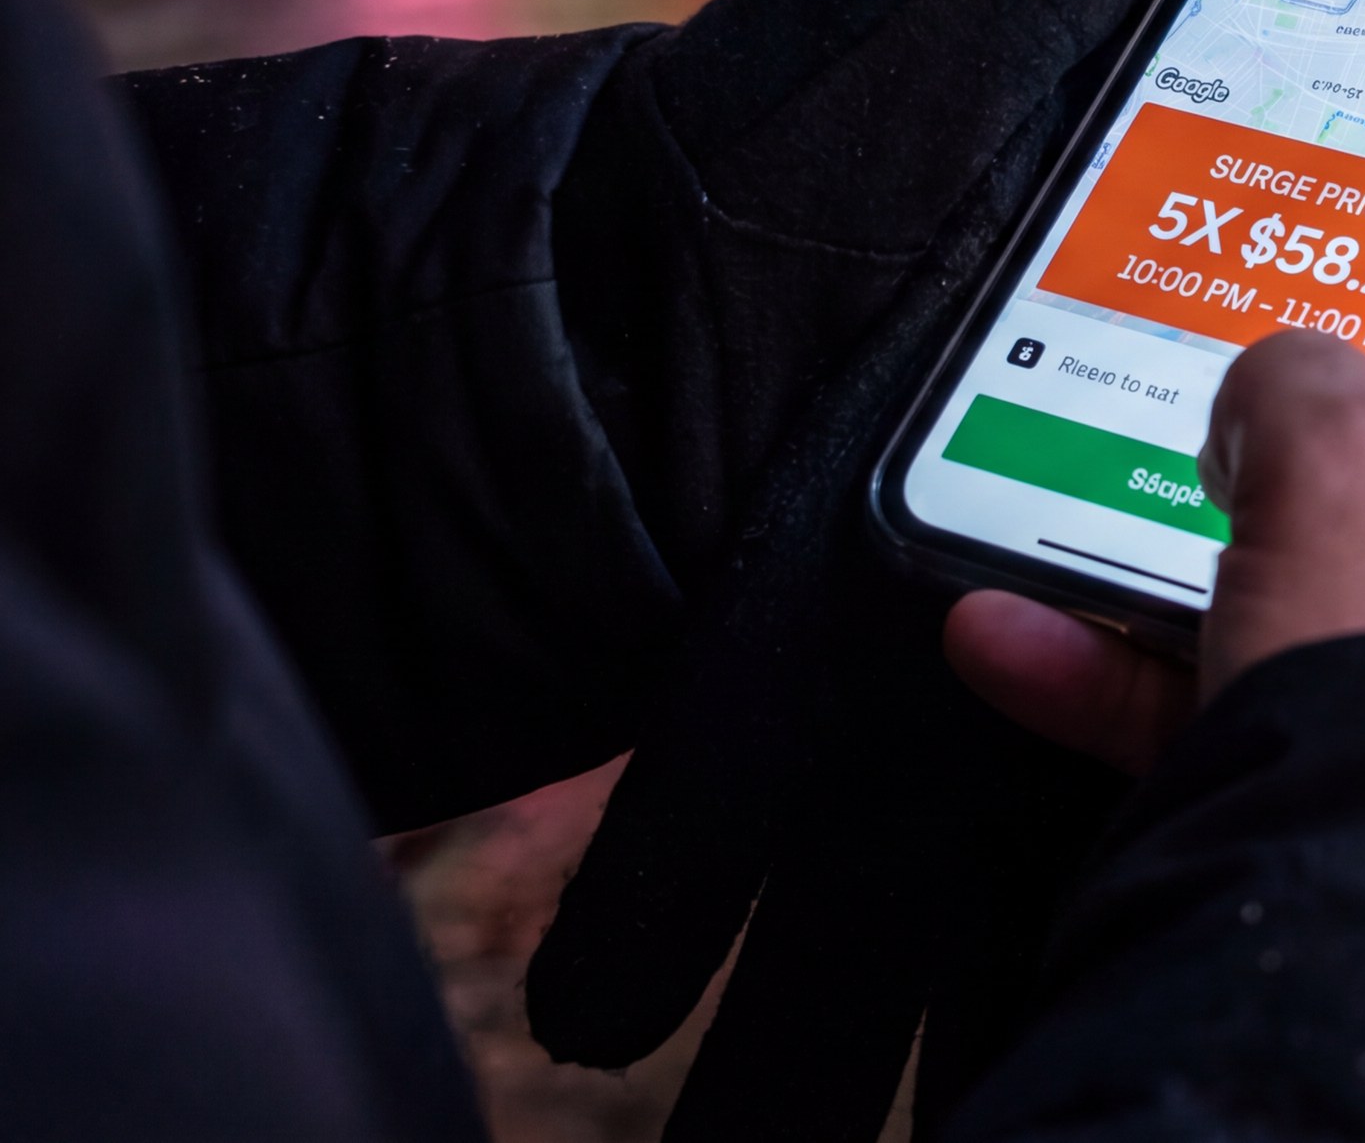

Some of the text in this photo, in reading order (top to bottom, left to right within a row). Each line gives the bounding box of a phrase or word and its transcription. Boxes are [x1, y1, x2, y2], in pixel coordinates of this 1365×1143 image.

[1155, 67, 1230, 103] Google
[1209, 154, 1317, 201] SURGE
[1148, 191, 1244, 255] 5X
[1117, 254, 1203, 297] 10:00
[1203, 278, 1257, 313] PM
[1276, 298, 1362, 341] 11:00
[1120, 373, 1141, 393] to
